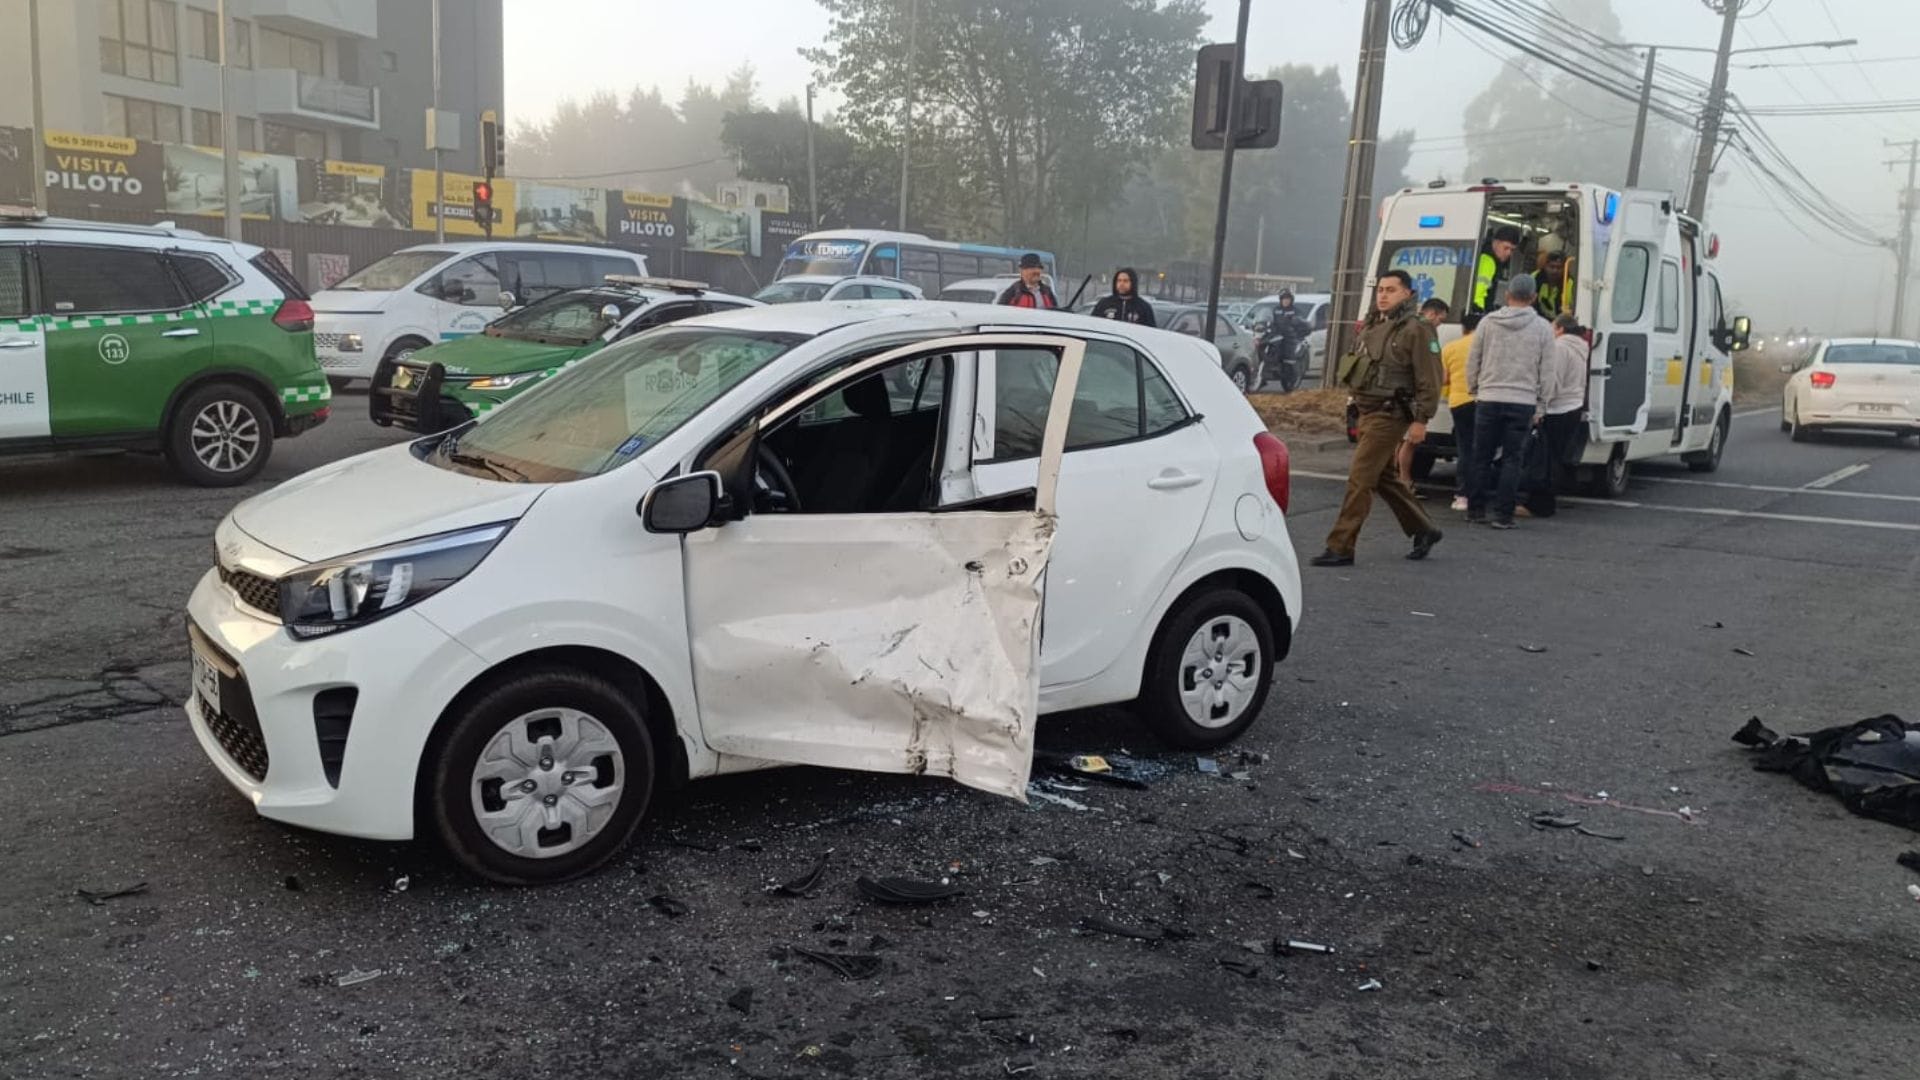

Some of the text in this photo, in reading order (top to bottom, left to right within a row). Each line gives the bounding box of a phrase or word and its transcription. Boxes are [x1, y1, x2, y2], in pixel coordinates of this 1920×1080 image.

[56, 155, 129, 176] VISITA
[45, 170, 143, 195] PILOTO
[628, 209, 668, 222] VISITA
[620, 220, 675, 237] PILOTO
[105, 348, 124, 359] 133
